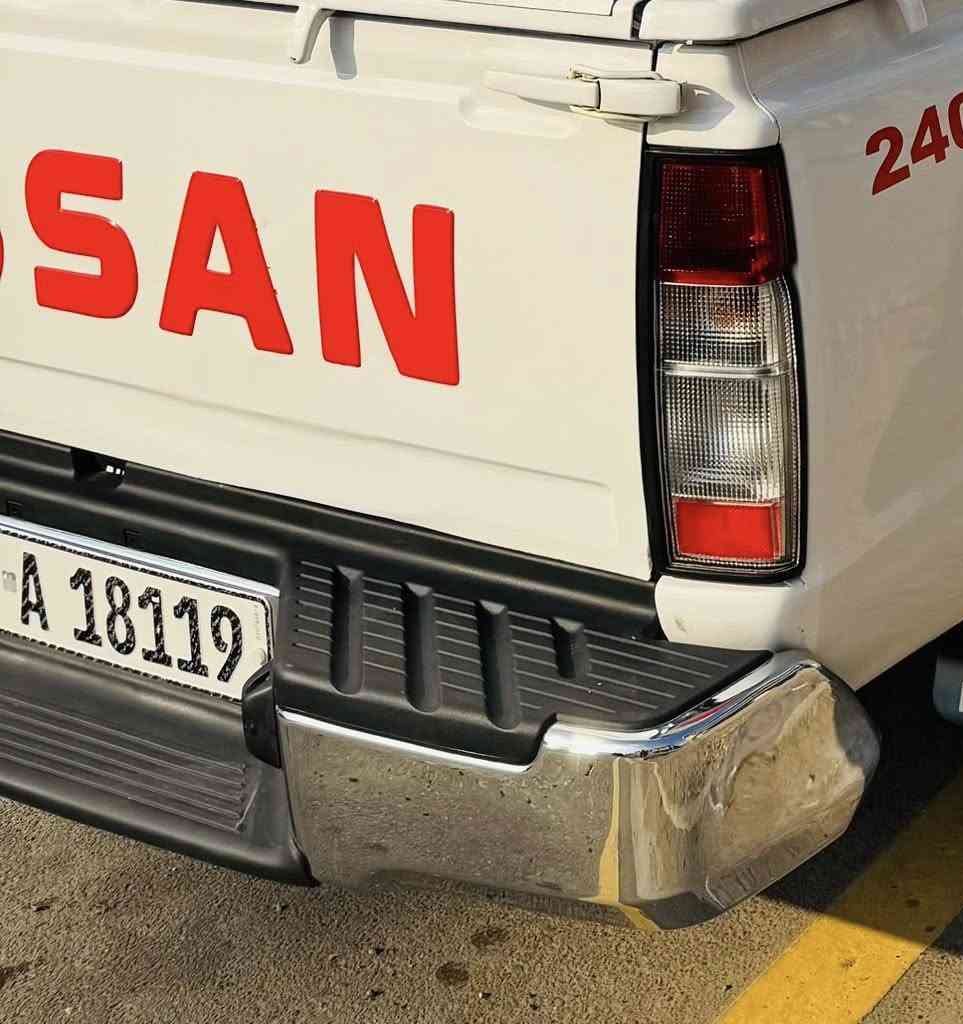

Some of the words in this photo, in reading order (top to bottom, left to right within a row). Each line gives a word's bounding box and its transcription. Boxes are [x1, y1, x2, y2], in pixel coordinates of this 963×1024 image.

[0, 149, 460, 386] SAN
[21, 551, 49, 631] A
[70, 567, 242, 682] 18119
